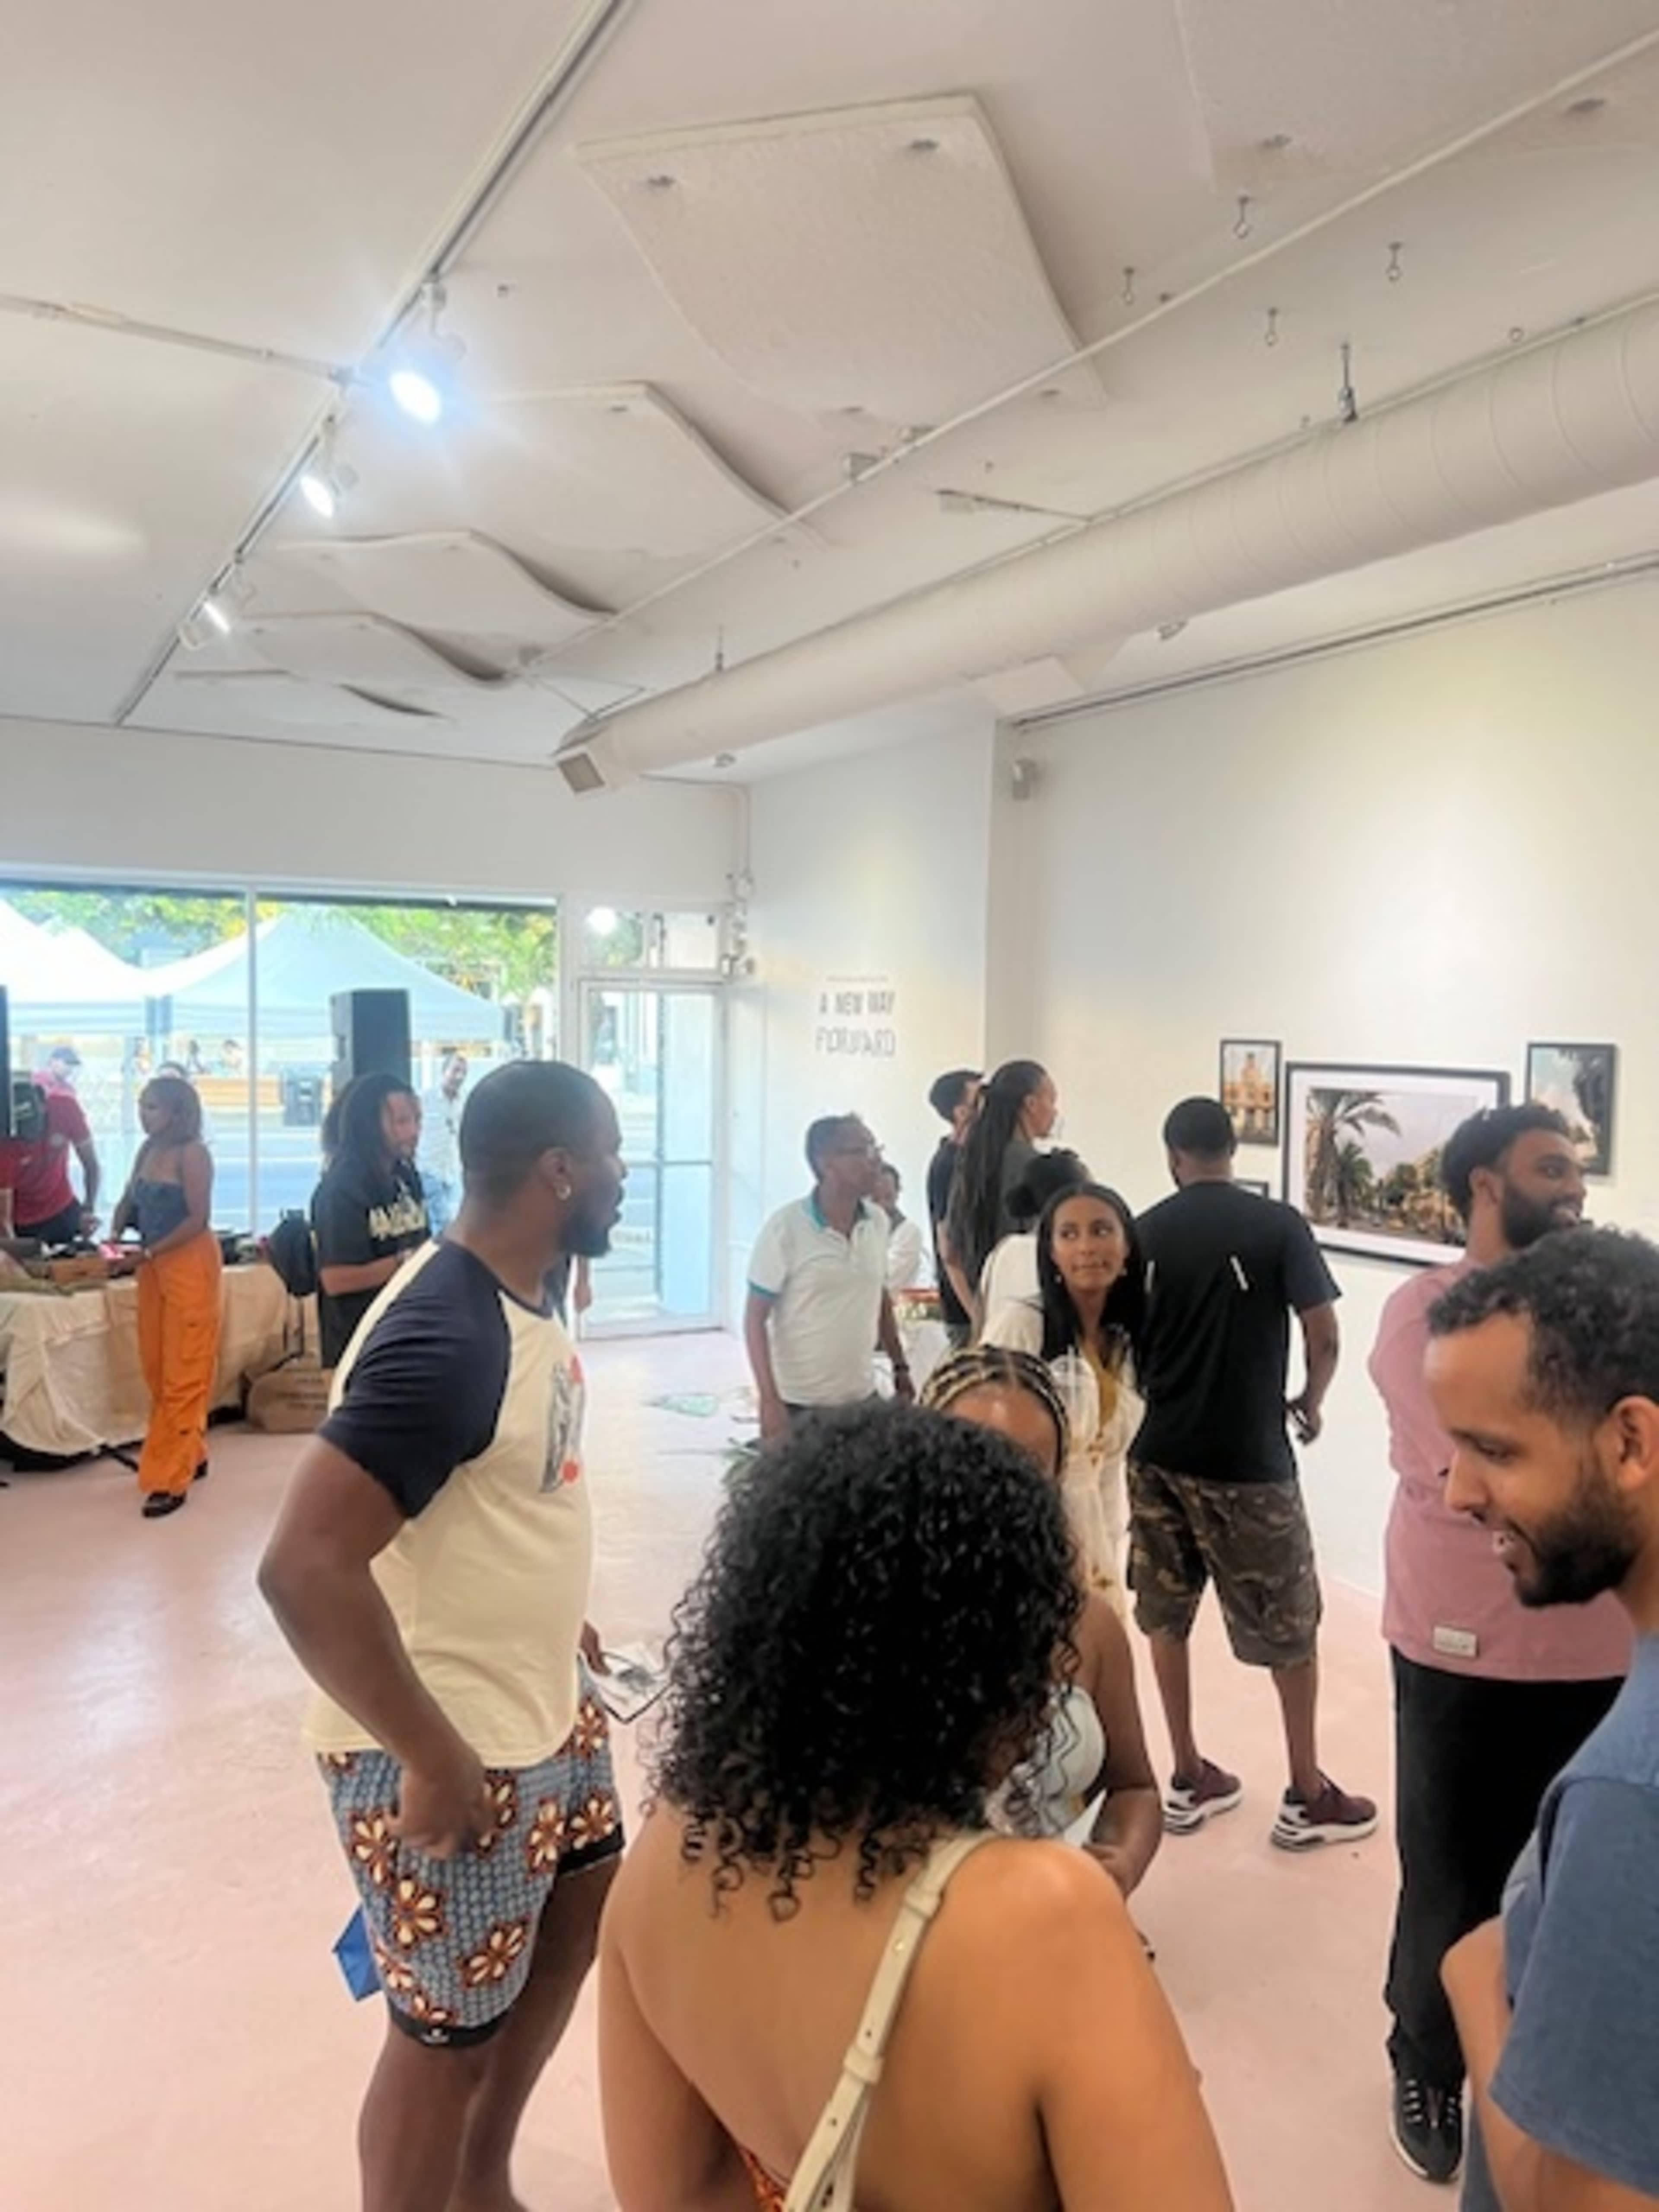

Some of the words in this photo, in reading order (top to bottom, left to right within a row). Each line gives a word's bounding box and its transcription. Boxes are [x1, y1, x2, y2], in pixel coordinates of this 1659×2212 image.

[820, 992, 828, 1014] A
[835, 992, 862, 1015] NEW
[868, 990, 895, 1014] WAY
